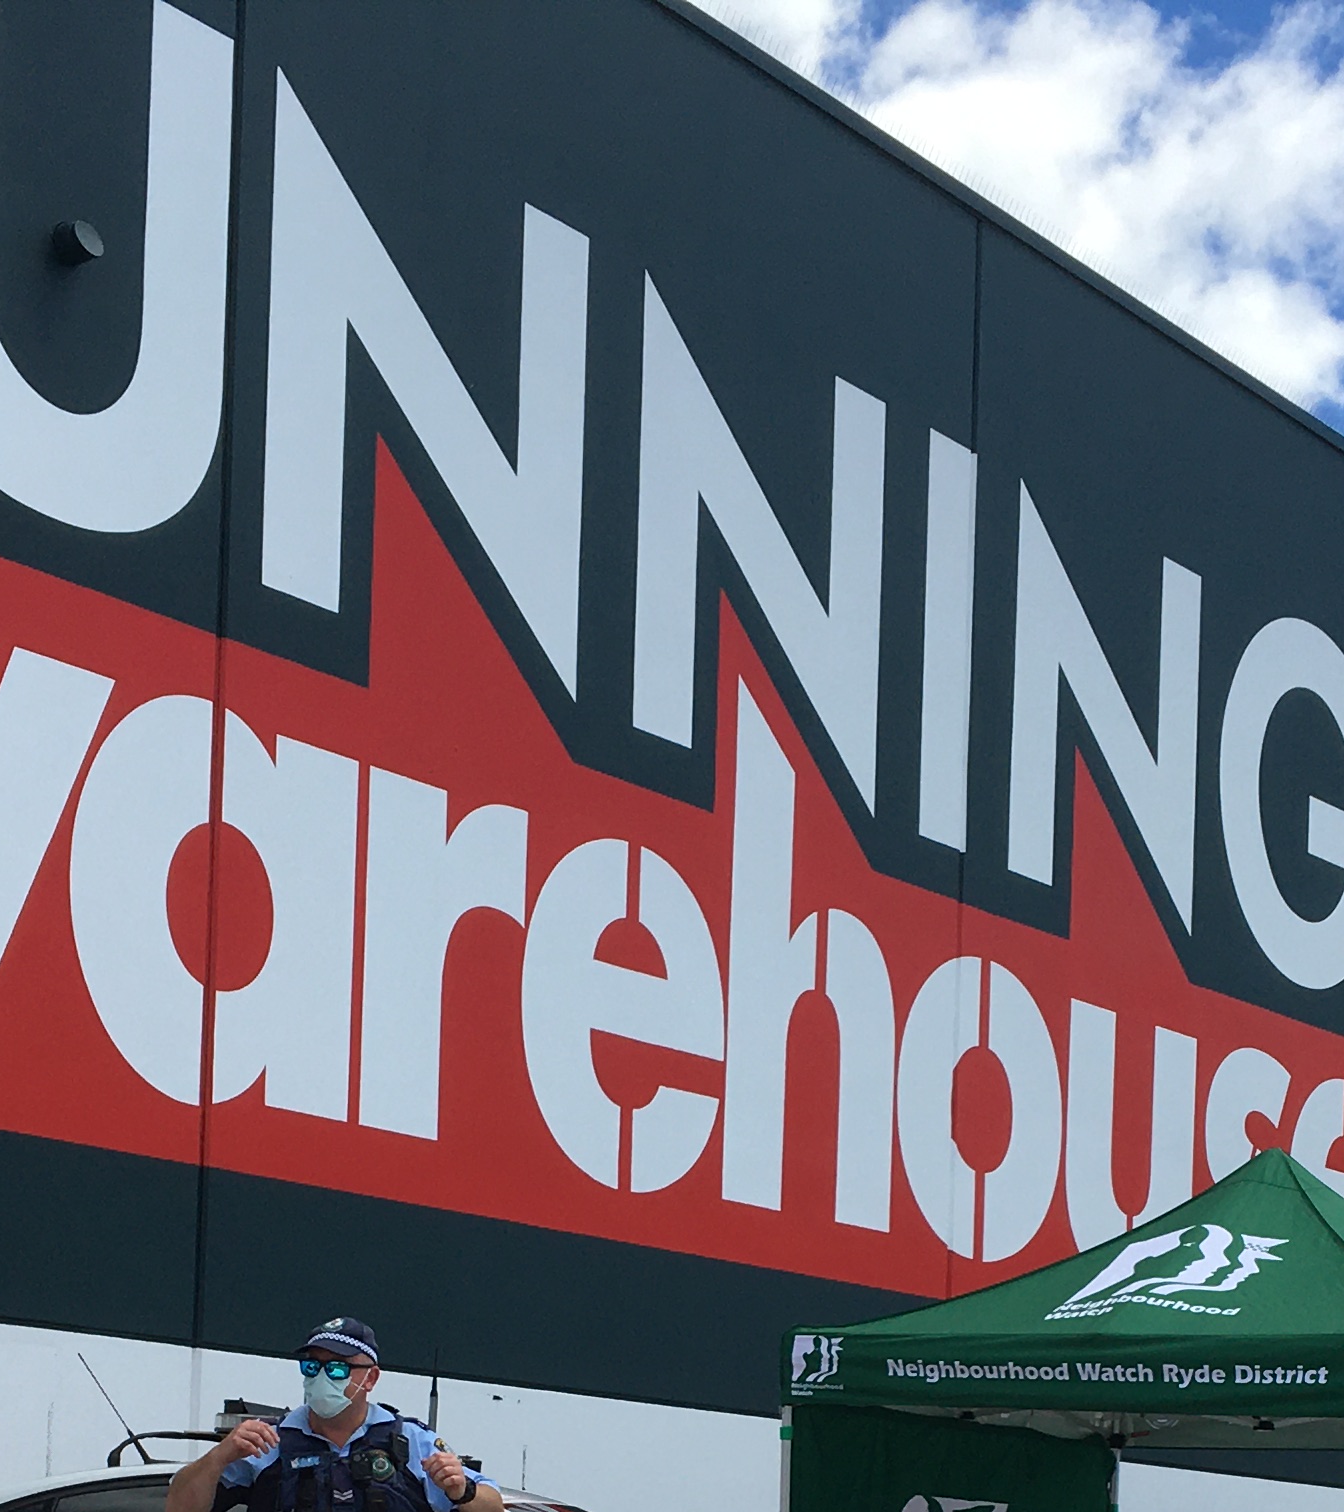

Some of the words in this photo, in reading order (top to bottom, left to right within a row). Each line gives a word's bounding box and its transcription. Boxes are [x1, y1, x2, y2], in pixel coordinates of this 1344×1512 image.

[1044, 1305, 1113, 1321] Watch
[1053, 1294, 1242, 1317] Neighbourhood
[886, 1358, 1070, 1383] Neighbourhood
[1075, 1363, 1154, 1383] Watch
[1162, 1363, 1226, 1388] Ryde
[1234, 1364, 1330, 1386] District
